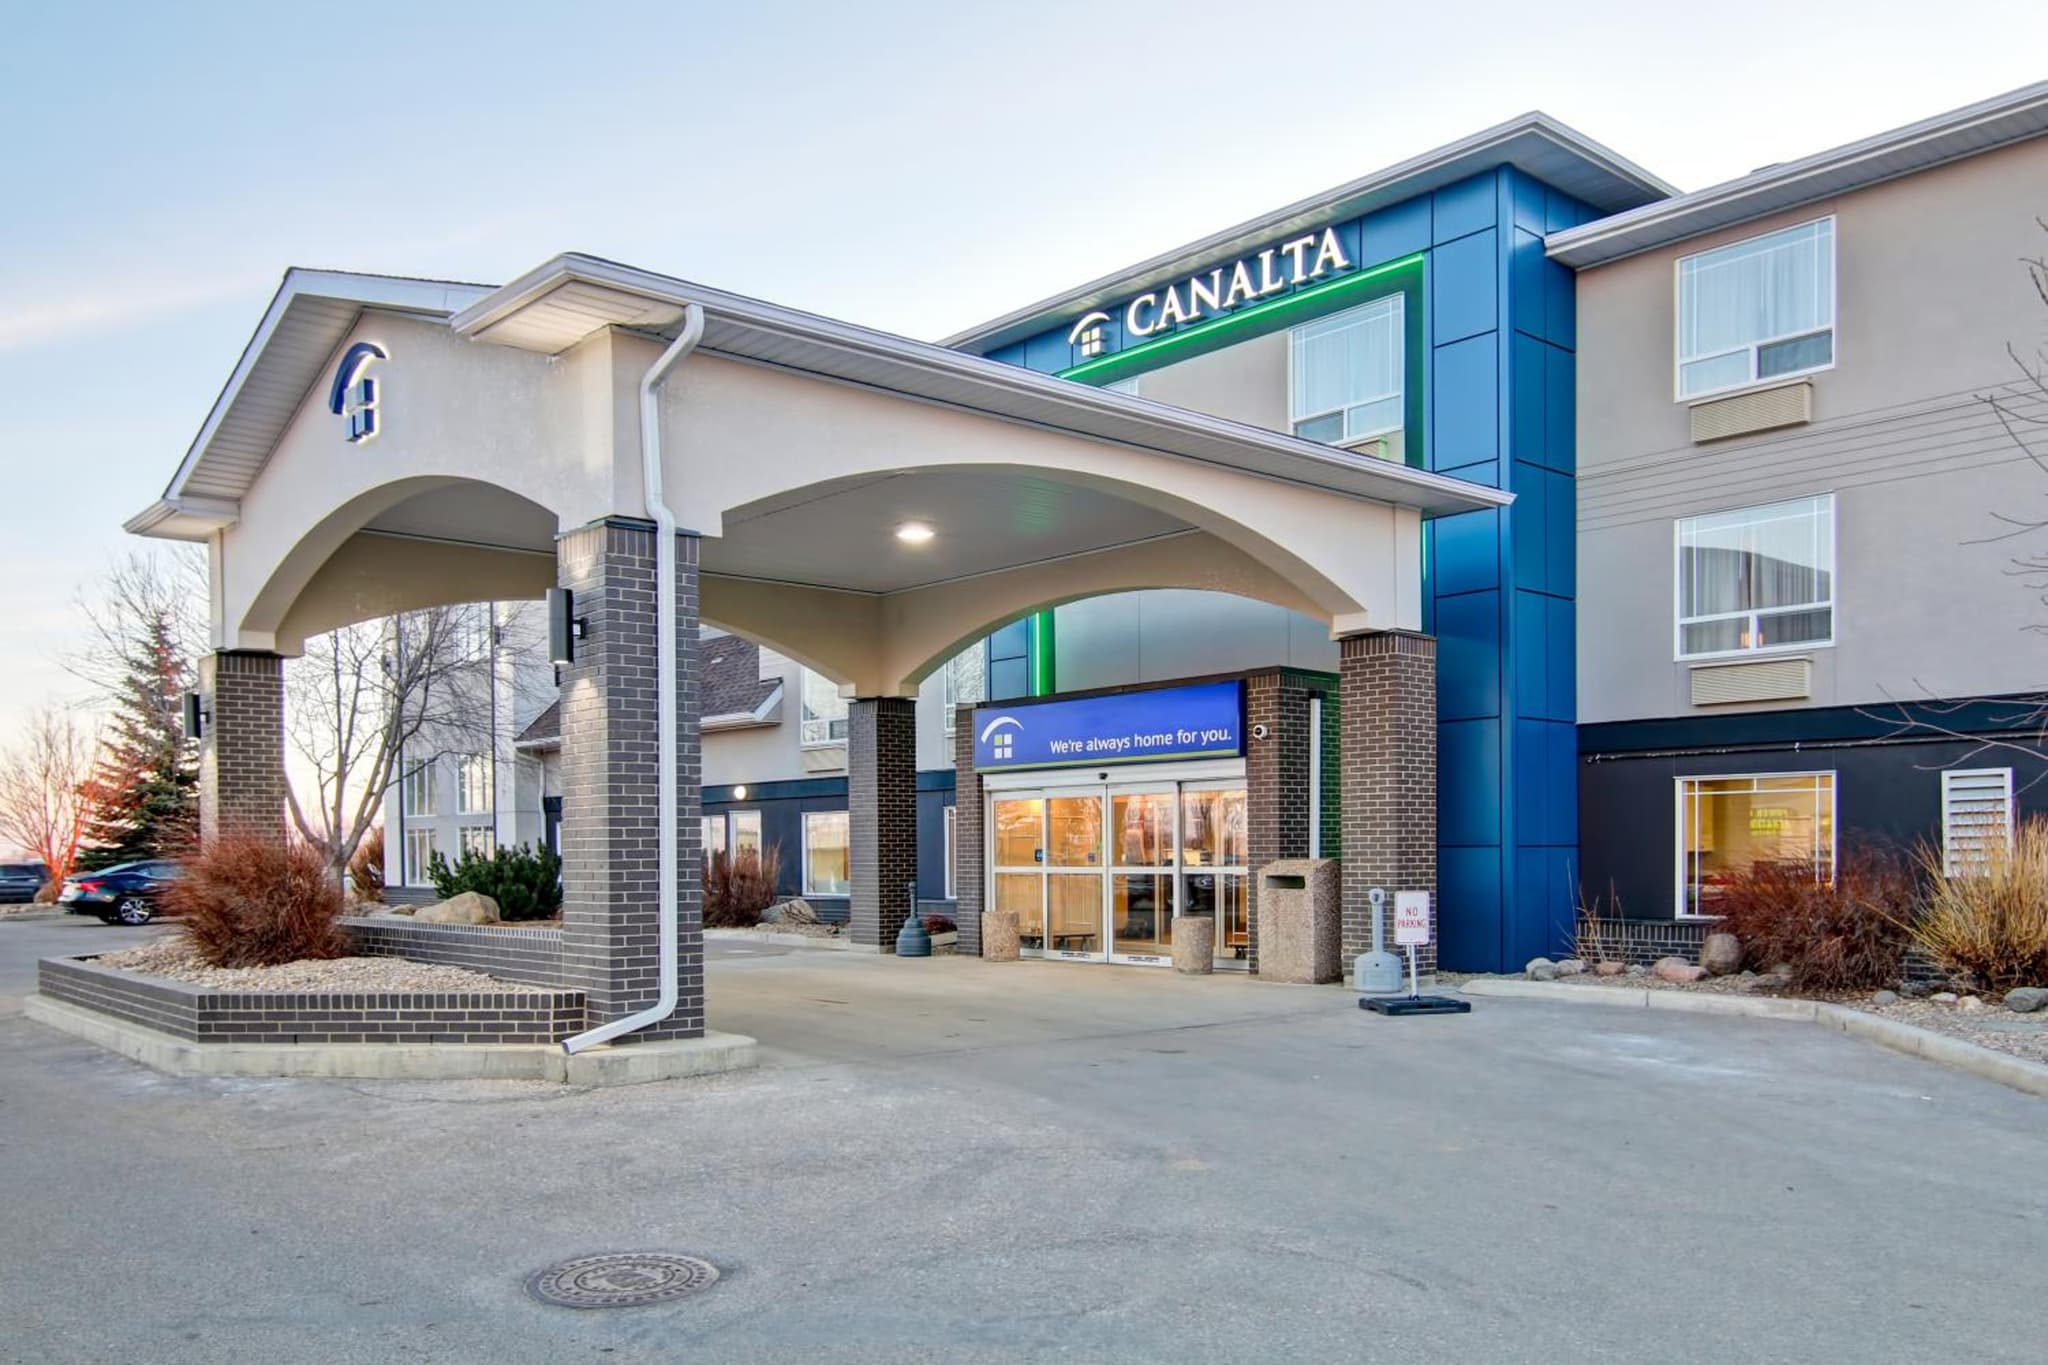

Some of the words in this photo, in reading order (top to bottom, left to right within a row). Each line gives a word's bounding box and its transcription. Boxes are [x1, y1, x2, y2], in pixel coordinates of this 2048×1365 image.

[1126, 227, 1349, 336] CANALTA
[1050, 739, 1083, 754] We're
[1086, 737, 1130, 752] always
[1134, 733, 1173, 748] home
[1177, 729, 1198, 745] for
[1200, 728, 1232, 746] you.
[1405, 906, 1418, 917] NO
[1397, 919, 1425, 928] PARKING
